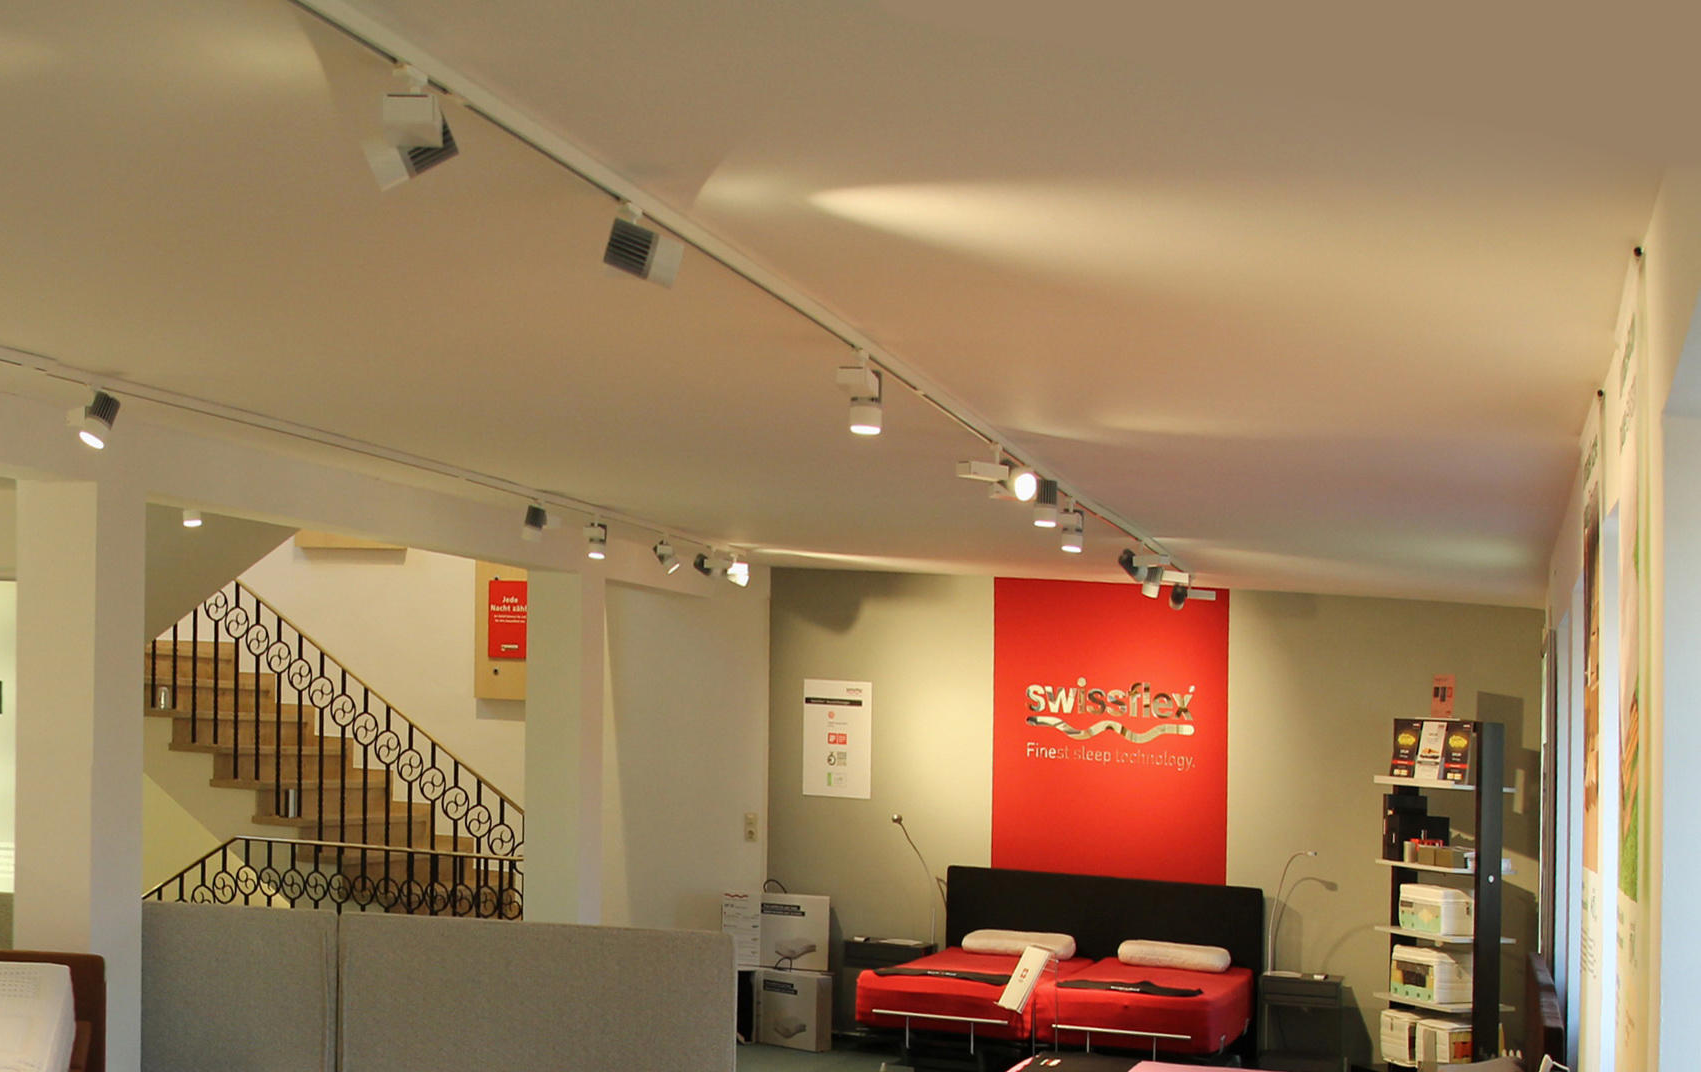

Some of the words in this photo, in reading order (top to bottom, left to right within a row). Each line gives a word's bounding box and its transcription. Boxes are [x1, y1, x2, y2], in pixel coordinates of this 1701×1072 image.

[490, 604, 511, 612] Nacht
[502, 596, 518, 604] Jede
[1026, 677, 1195, 720] swissflex
[1026, 742, 1069, 759] Finest
[1074, 745, 1111, 763] sleep
[1116, 749, 1196, 771] technology.
